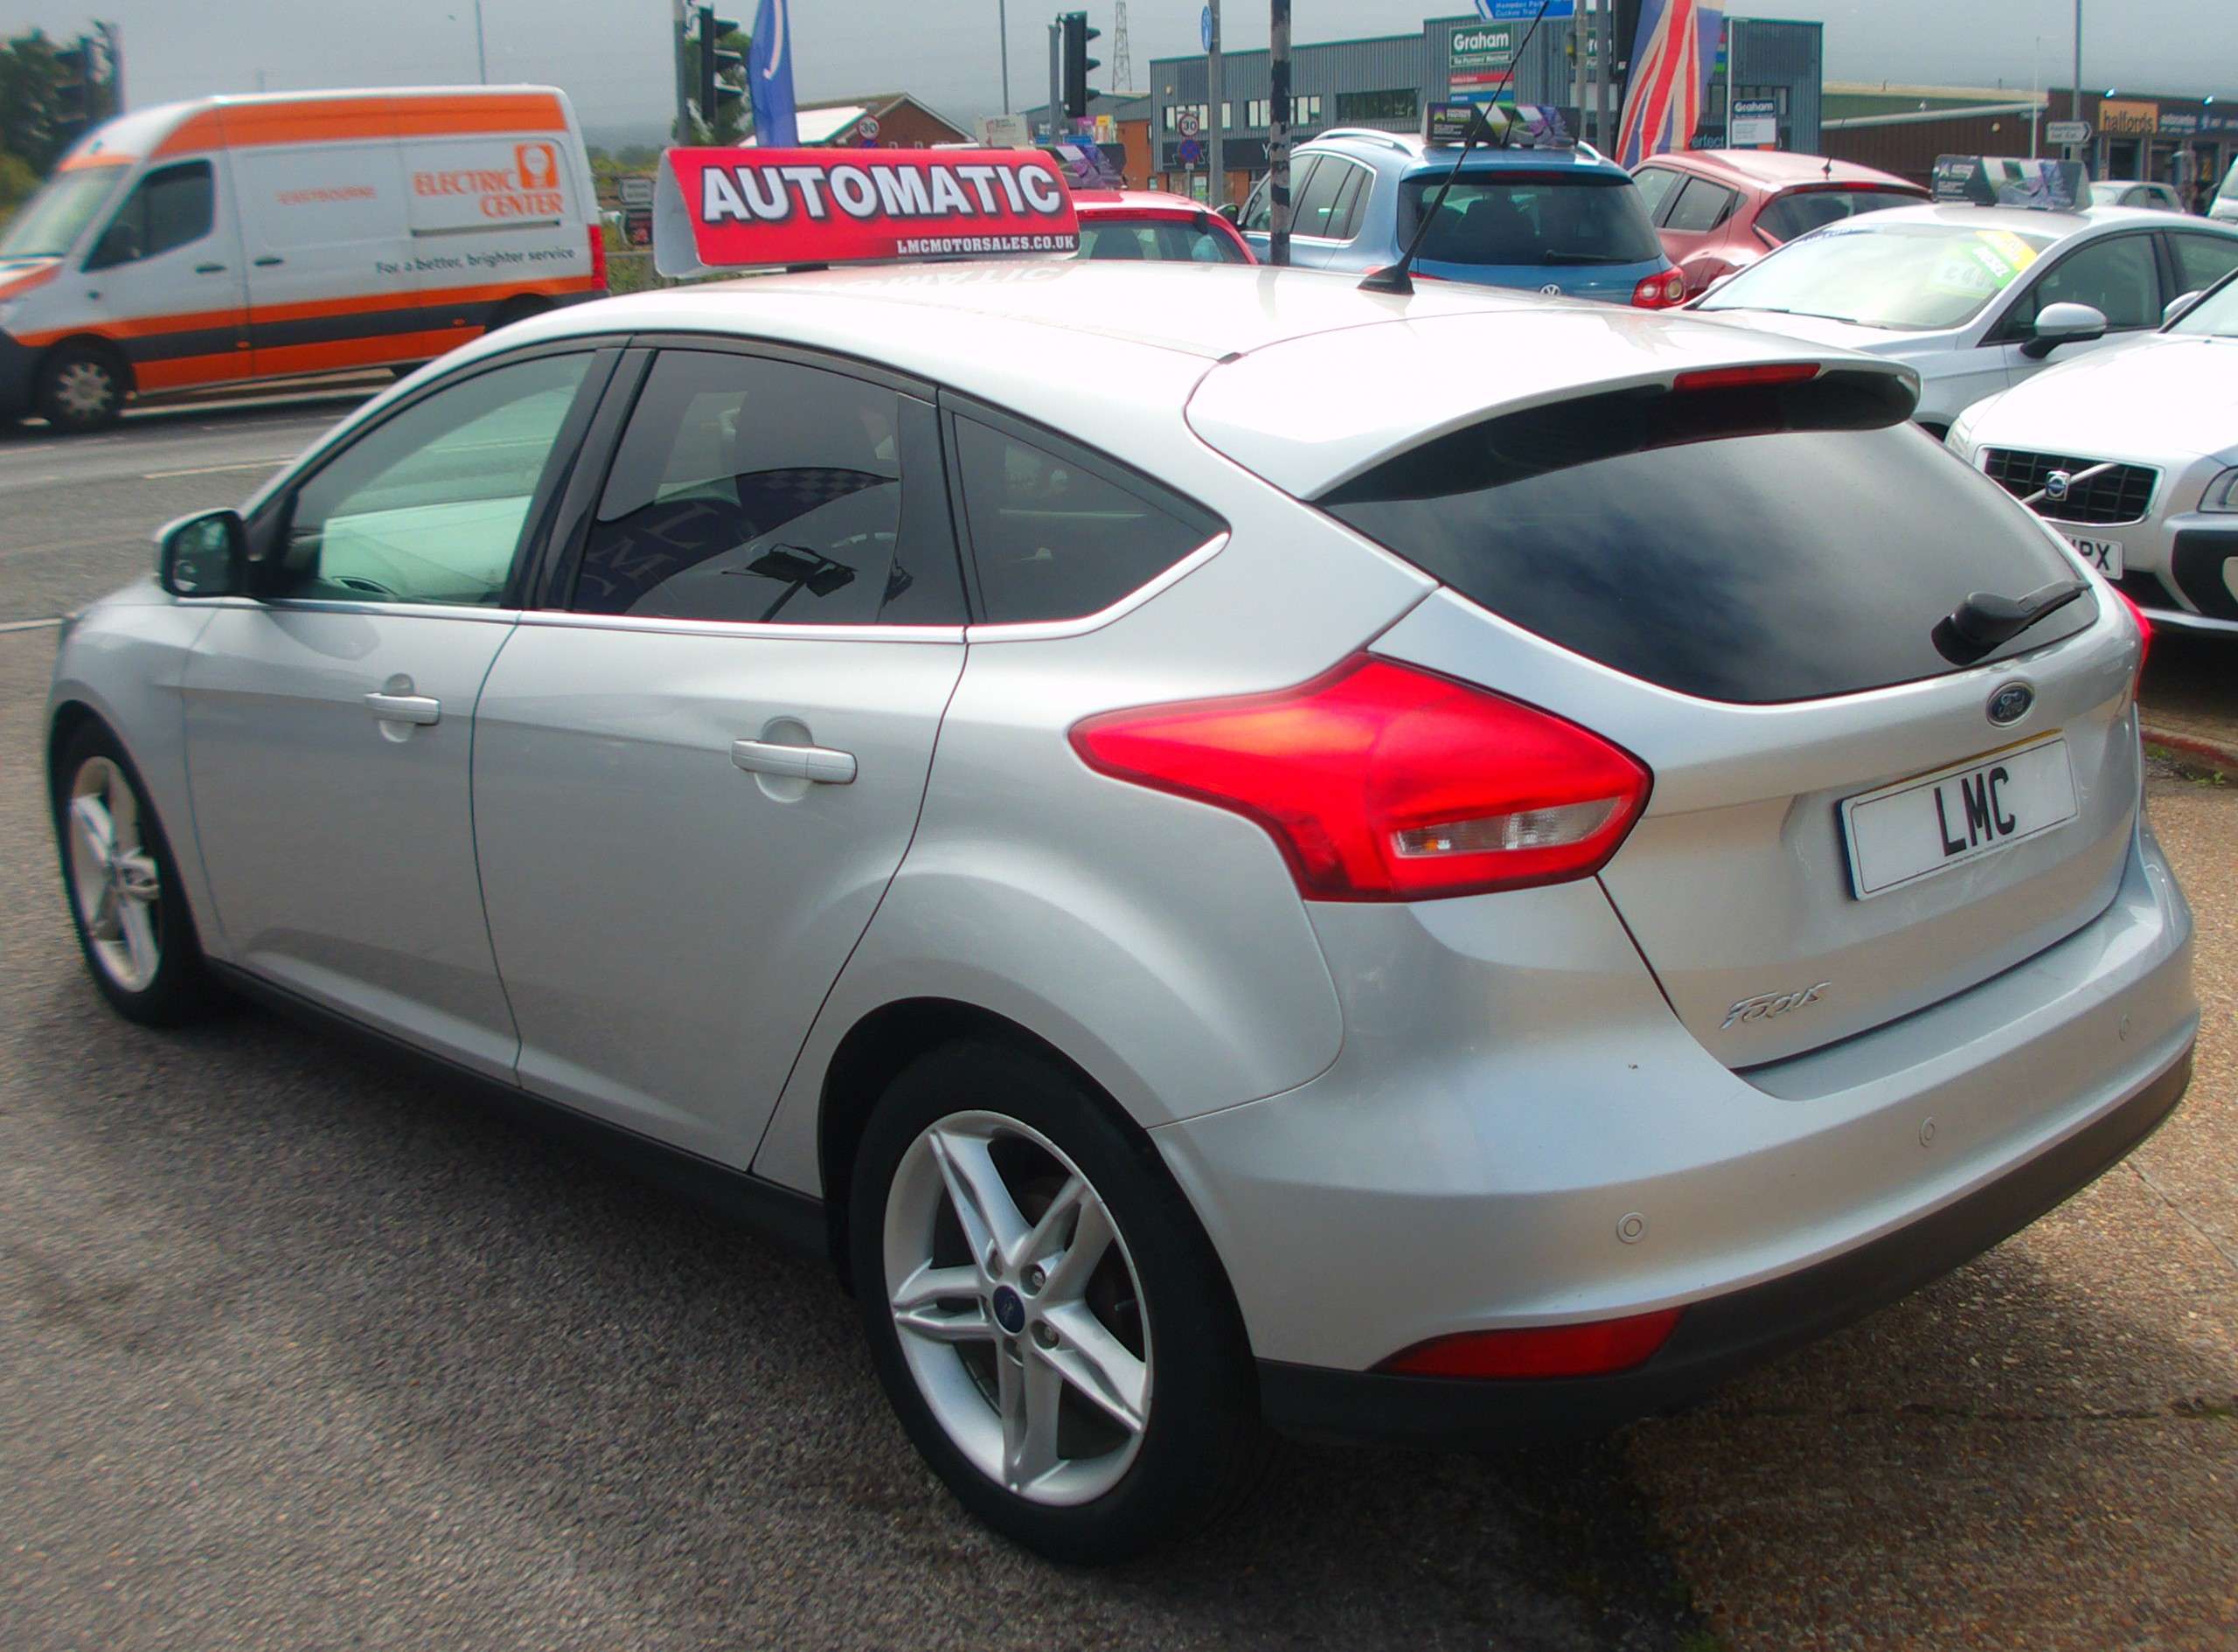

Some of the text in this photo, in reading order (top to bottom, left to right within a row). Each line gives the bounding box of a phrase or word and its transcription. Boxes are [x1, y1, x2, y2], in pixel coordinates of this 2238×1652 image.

[1453, 31, 1509, 52] Graham
[1734, 101, 1774, 113] Graham
[1183, 120, 1197, 131] 30
[2103, 110, 2154, 133] halfords
[1692, 135, 1725, 149] erfect
[413, 169, 516, 197] ELECTRIC
[701, 163, 1062, 224] AUTOMATIC
[481, 191, 565, 218] CENTER
[896, 234, 1075, 254] LMCMOTORSALES.CO.UK
[375, 261, 400, 274] For
[404, 262, 414, 272] a
[467, 251, 524, 268] brighter
[527, 247, 575, 260] service
[2071, 539, 2110, 571] PX
[1934, 766, 2016, 857] LMC
[1719, 980, 1831, 1030] Focus
